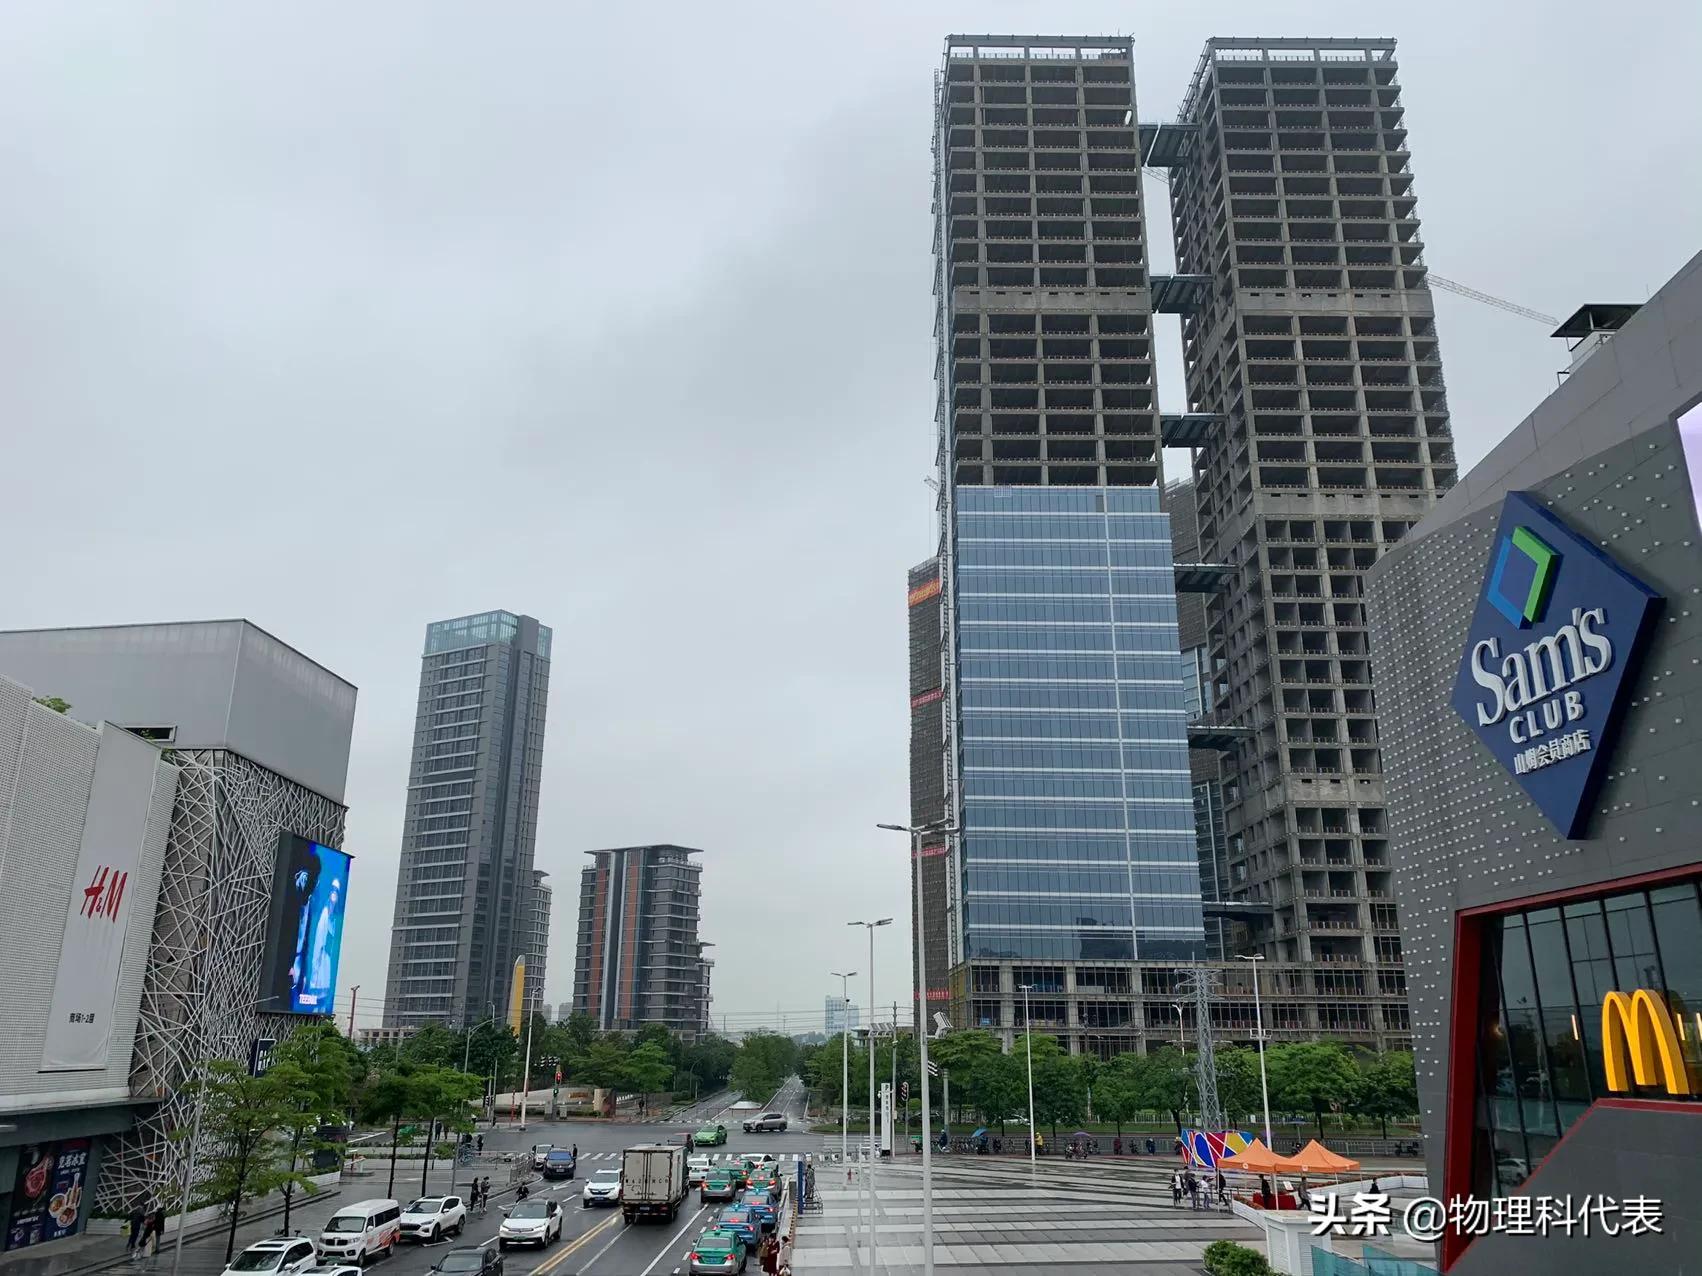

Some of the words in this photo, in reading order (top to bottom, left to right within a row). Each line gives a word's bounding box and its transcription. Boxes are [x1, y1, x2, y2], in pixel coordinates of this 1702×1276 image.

[1471, 607, 1612, 727] Sam's
[1509, 691, 1584, 743] CLUB
[80, 865, 128, 923] H&M
